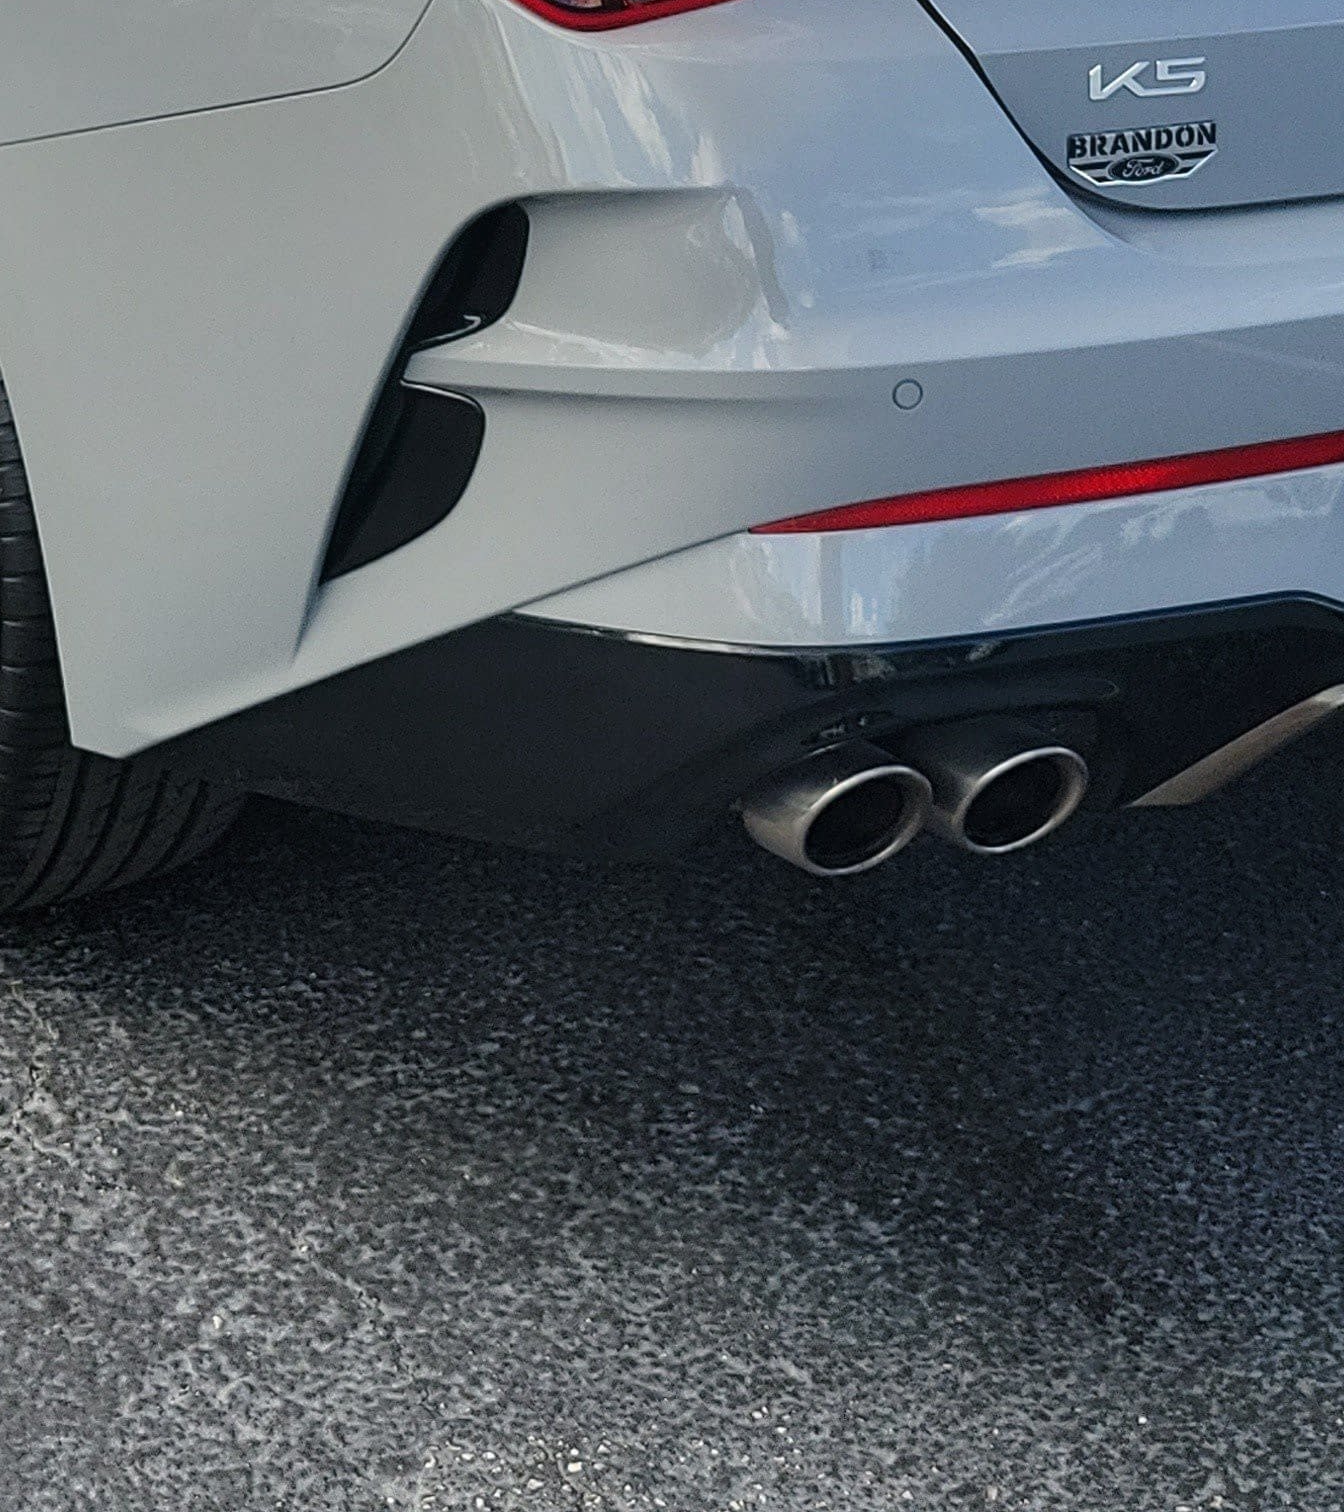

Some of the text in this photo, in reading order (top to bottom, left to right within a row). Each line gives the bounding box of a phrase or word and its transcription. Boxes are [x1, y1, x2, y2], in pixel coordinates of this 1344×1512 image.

[1088, 57, 1206, 101] K5
[1067, 120, 1217, 159] BRANDON
[1121, 158, 1165, 178] Ford
